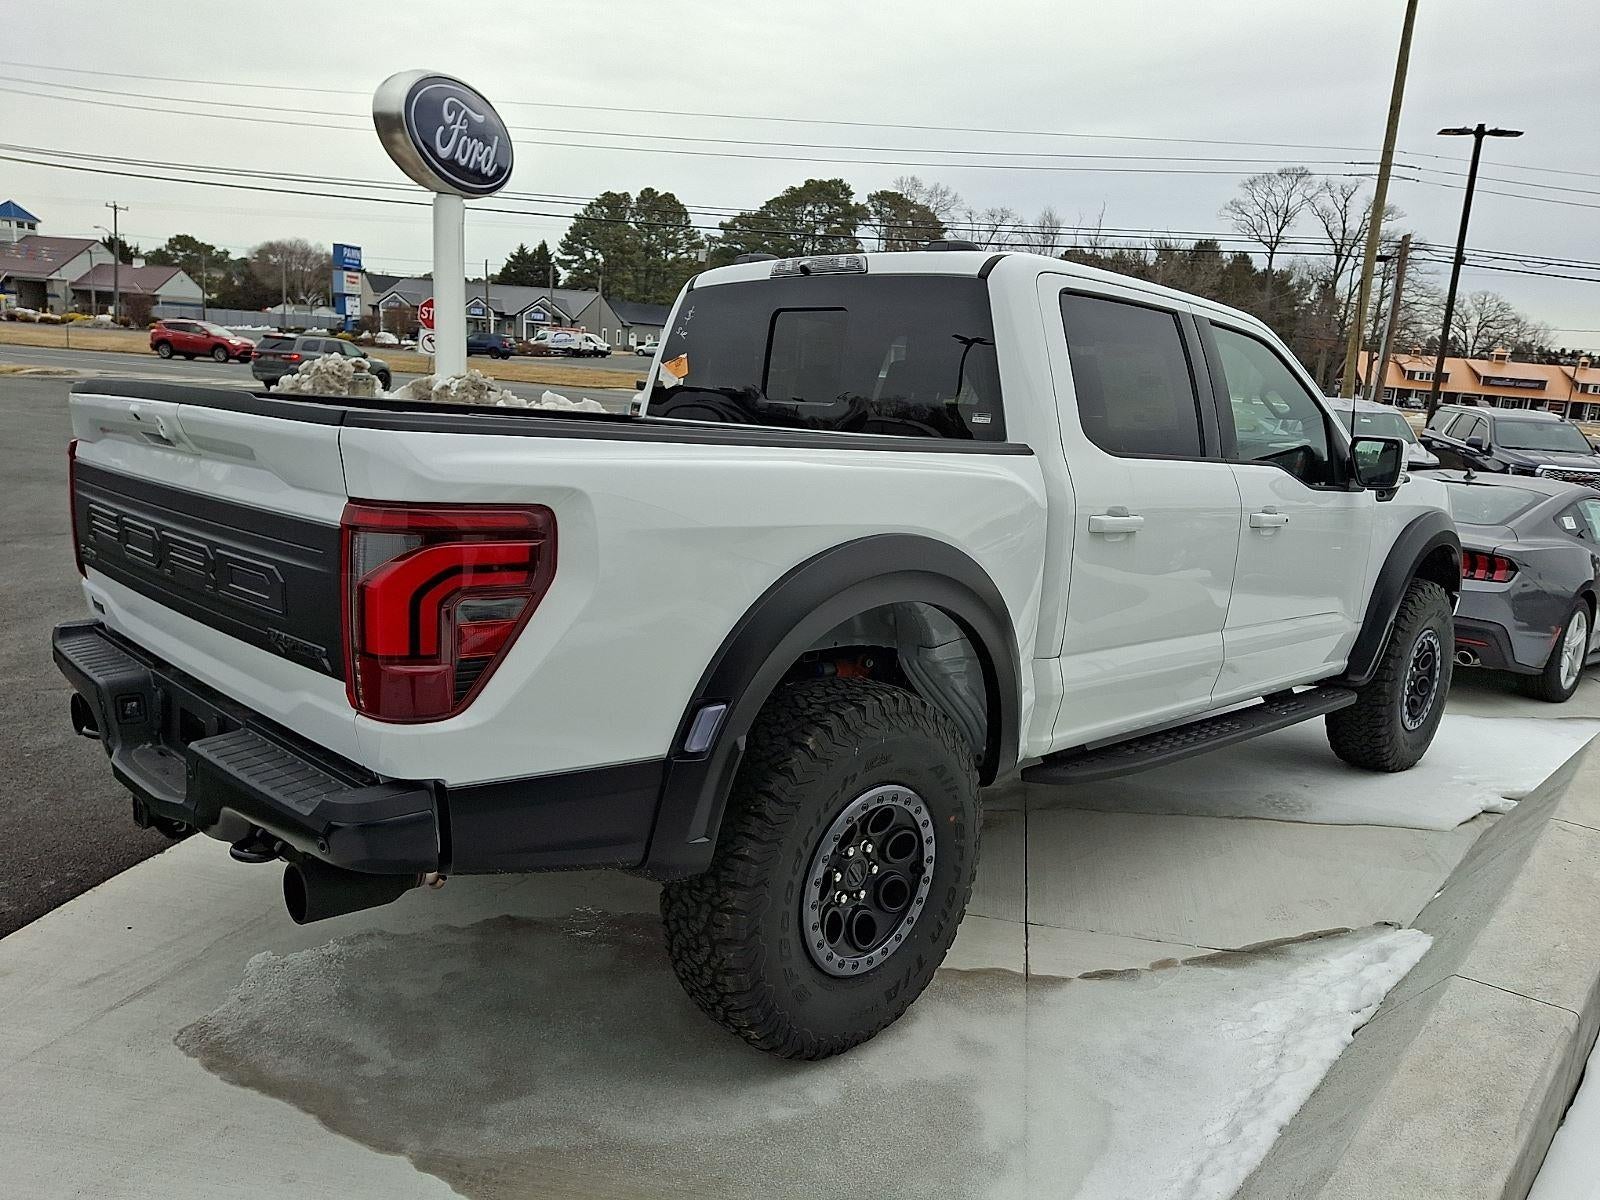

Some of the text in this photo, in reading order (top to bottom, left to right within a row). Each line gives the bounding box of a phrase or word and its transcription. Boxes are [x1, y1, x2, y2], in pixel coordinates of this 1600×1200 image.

[435, 96, 499, 177] Ford
[420, 306, 435, 320] ST
[87, 503, 288, 614] FORD
